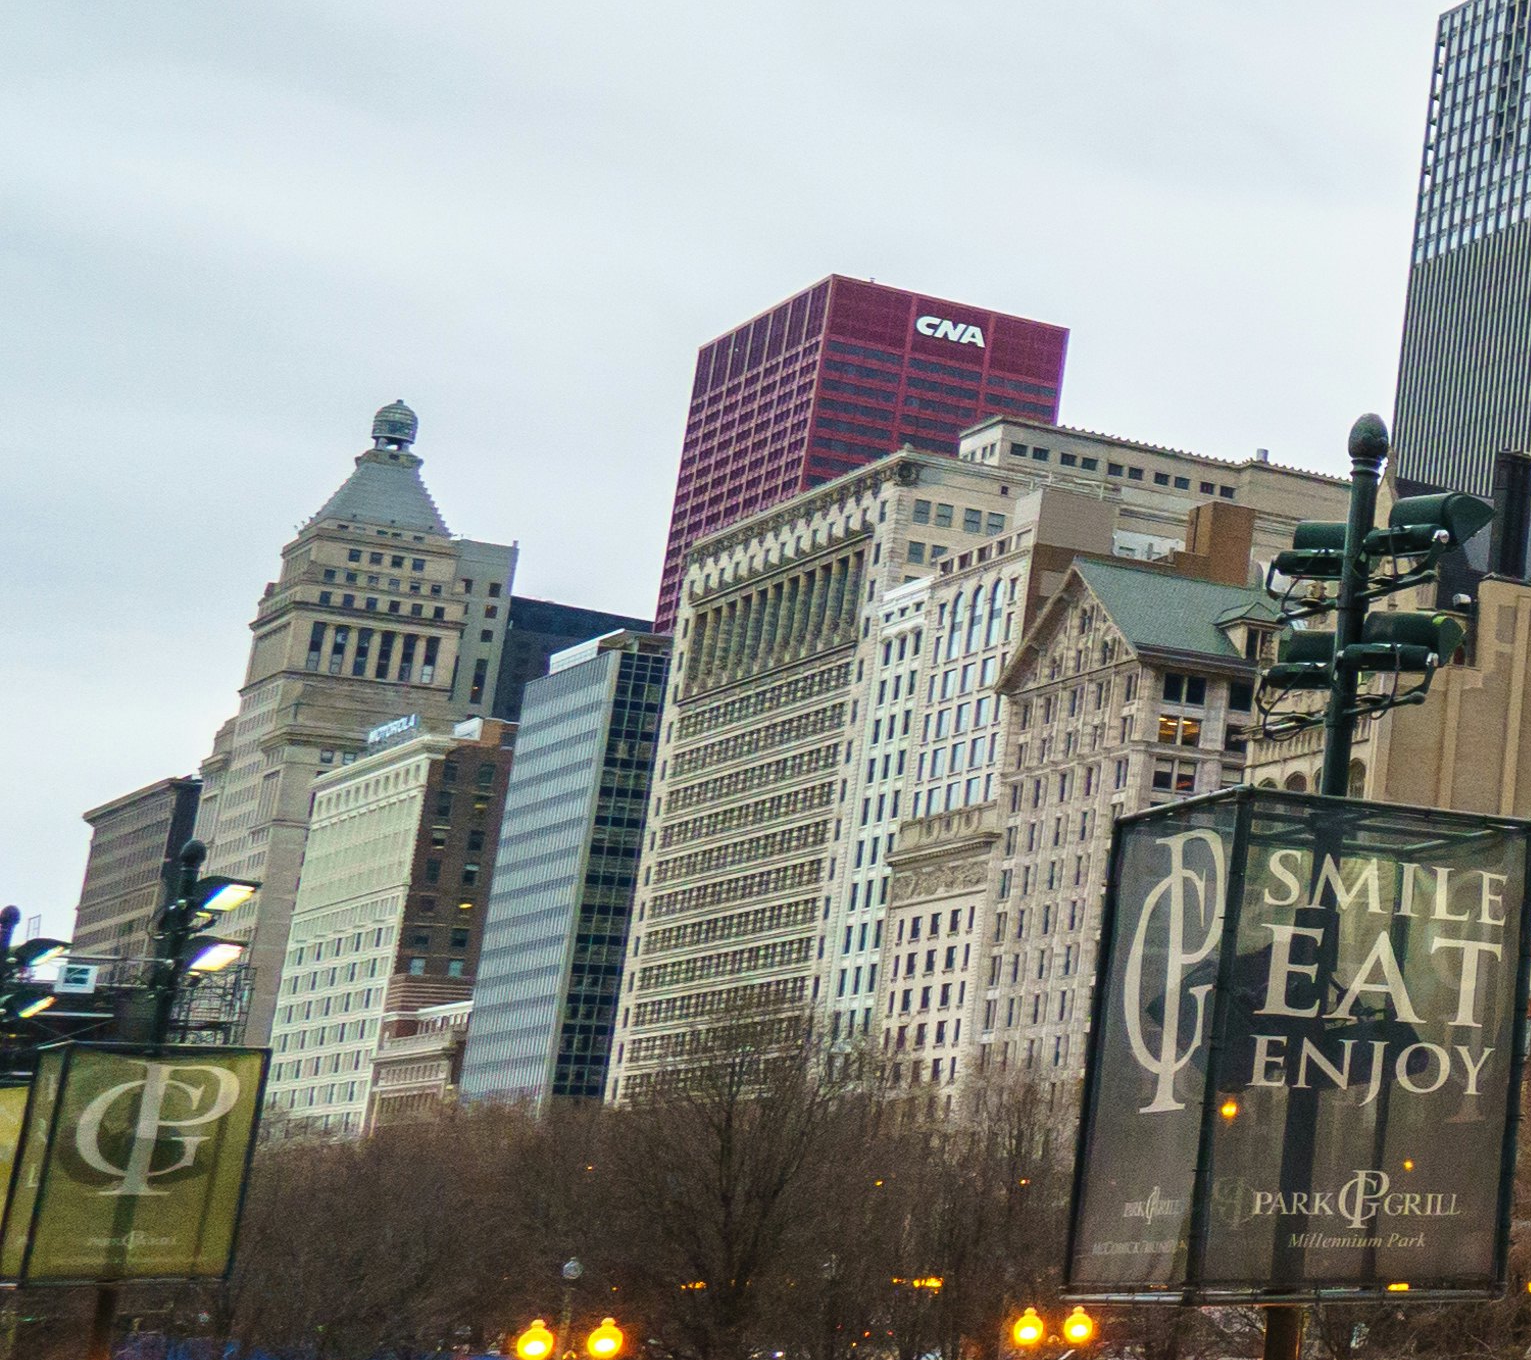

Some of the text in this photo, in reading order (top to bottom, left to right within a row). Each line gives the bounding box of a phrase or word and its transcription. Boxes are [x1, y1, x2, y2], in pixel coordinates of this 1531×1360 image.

[916, 315, 986, 348] CNA
[1263, 849, 1508, 927] SMILE
[1253, 922, 1503, 1029] EAT
[1246, 1033, 1496, 1108] ENJOY
[1252, 1190, 1335, 1216] PARK
[1383, 1192, 1463, 1216] GRILL
[1287, 1232, 1426, 1249] Millennium Park
